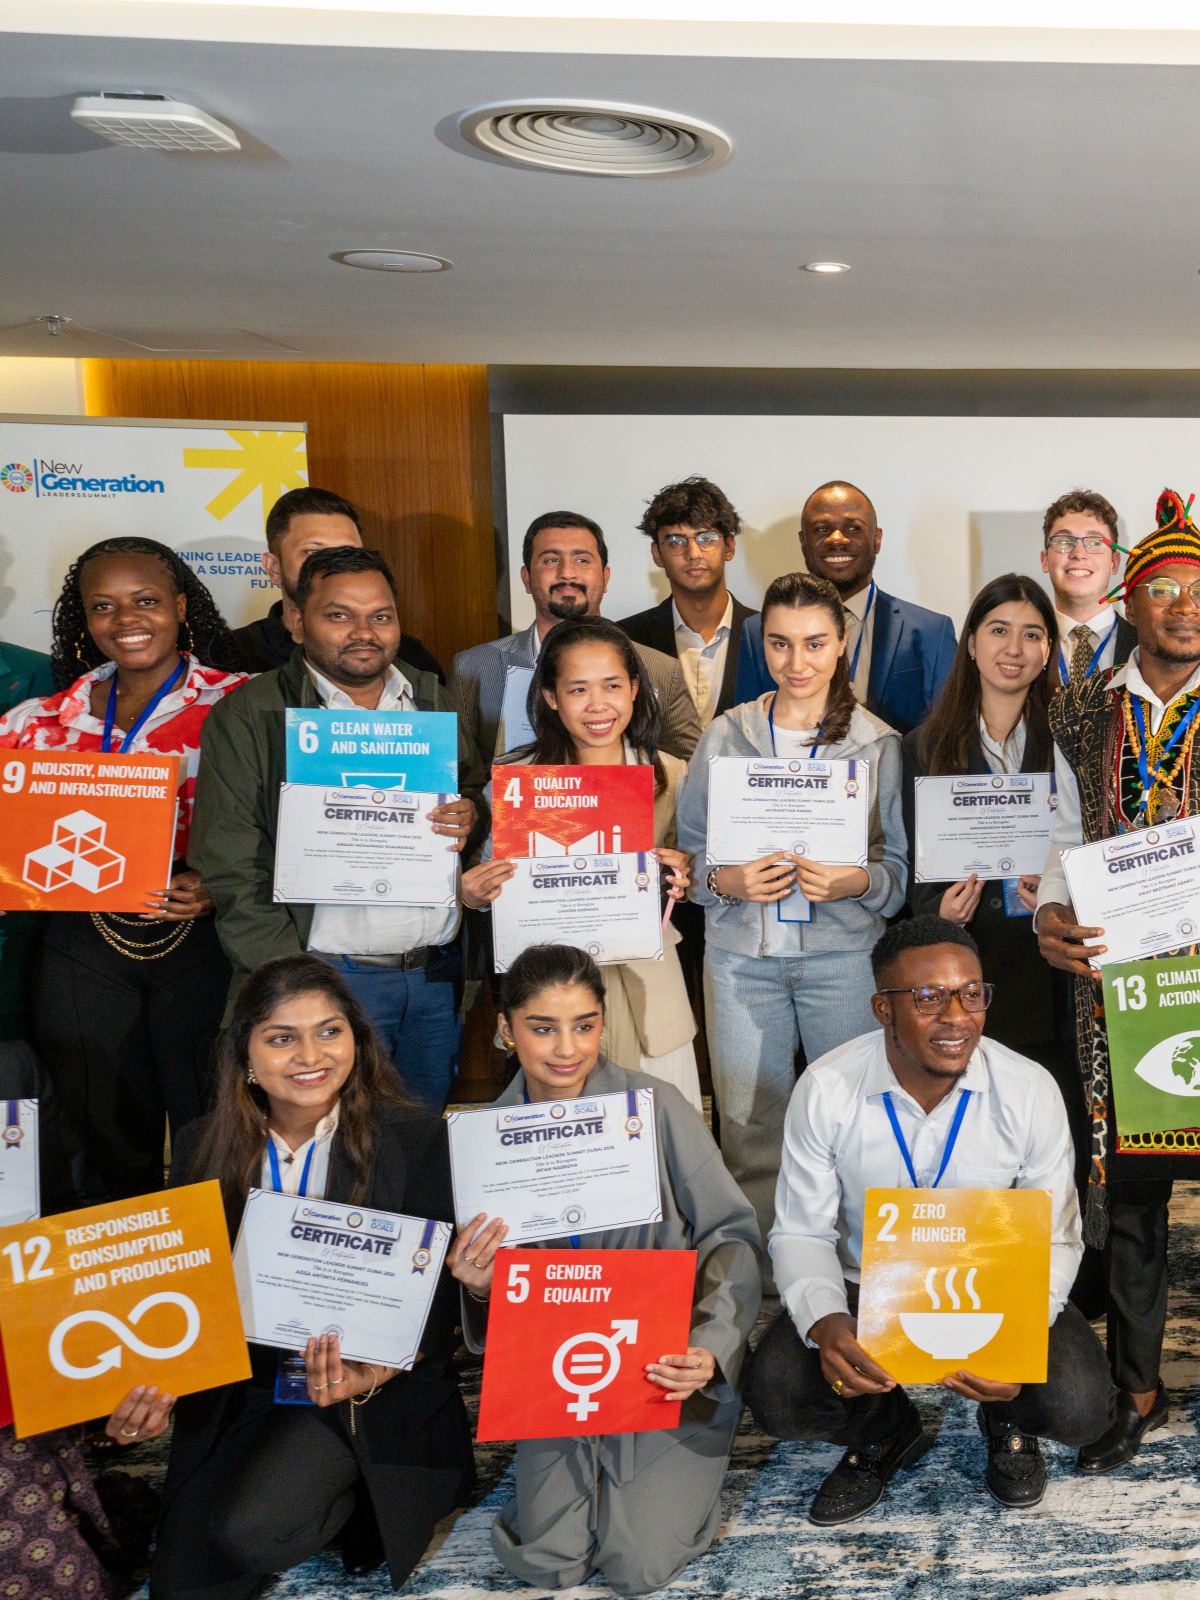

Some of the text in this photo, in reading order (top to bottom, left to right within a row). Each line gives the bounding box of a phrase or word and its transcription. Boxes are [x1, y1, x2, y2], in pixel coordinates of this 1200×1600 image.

[40, 459, 82, 474] New
[41, 473, 165, 493] Generation
[218, 552, 262, 562] LEADE
[197, 565, 267, 575] A SUSTAIN
[299, 720, 319, 754] 6
[331, 722, 413, 736] CLEAN WATER
[331, 741, 429, 755] AND SANITATION
[2, 760, 26, 794] 9
[32, 762, 169, 780] INDUSTRY, INNOVATION
[28, 781, 168, 799] AND INFRASTRUCTURE
[534, 777, 582, 790] QUALITY
[748, 777, 828, 789] CERTIFICATE
[504, 777, 523, 808] 4
[534, 795, 598, 808] EDUCATION
[953, 794, 1031, 807] CERTIFICATE
[324, 808, 414, 824] CERTIFICATE
[1116, 840, 1143, 851] Generation
[1108, 842, 1195, 874] CERTIFICATE
[532, 874, 618, 889] CERTIFICATE
[1112, 974, 1147, 1012] 13
[1159, 990, 1200, 1008] ACTION
[514, 1113, 545, 1122] Generation
[500, 1120, 603, 1146] CERTIFICATE
[311, 1211, 342, 1222] Generation
[912, 1203, 946, 1219] ZERO
[65, 1207, 171, 1246] RESPONSIBLE
[876, 1203, 900, 1242] 2
[290, 1225, 394, 1256] CERTIFICATE
[912, 1227, 966, 1243] HUNGER
[69, 1229, 184, 1271] CONSUMPTION
[2, 1235, 54, 1285] 12
[74, 1248, 212, 1295] AND PRODUCTION
[546, 1264, 603, 1280] GENDER
[506, 1264, 530, 1304] 5
[544, 1287, 612, 1305] EQUALITY
